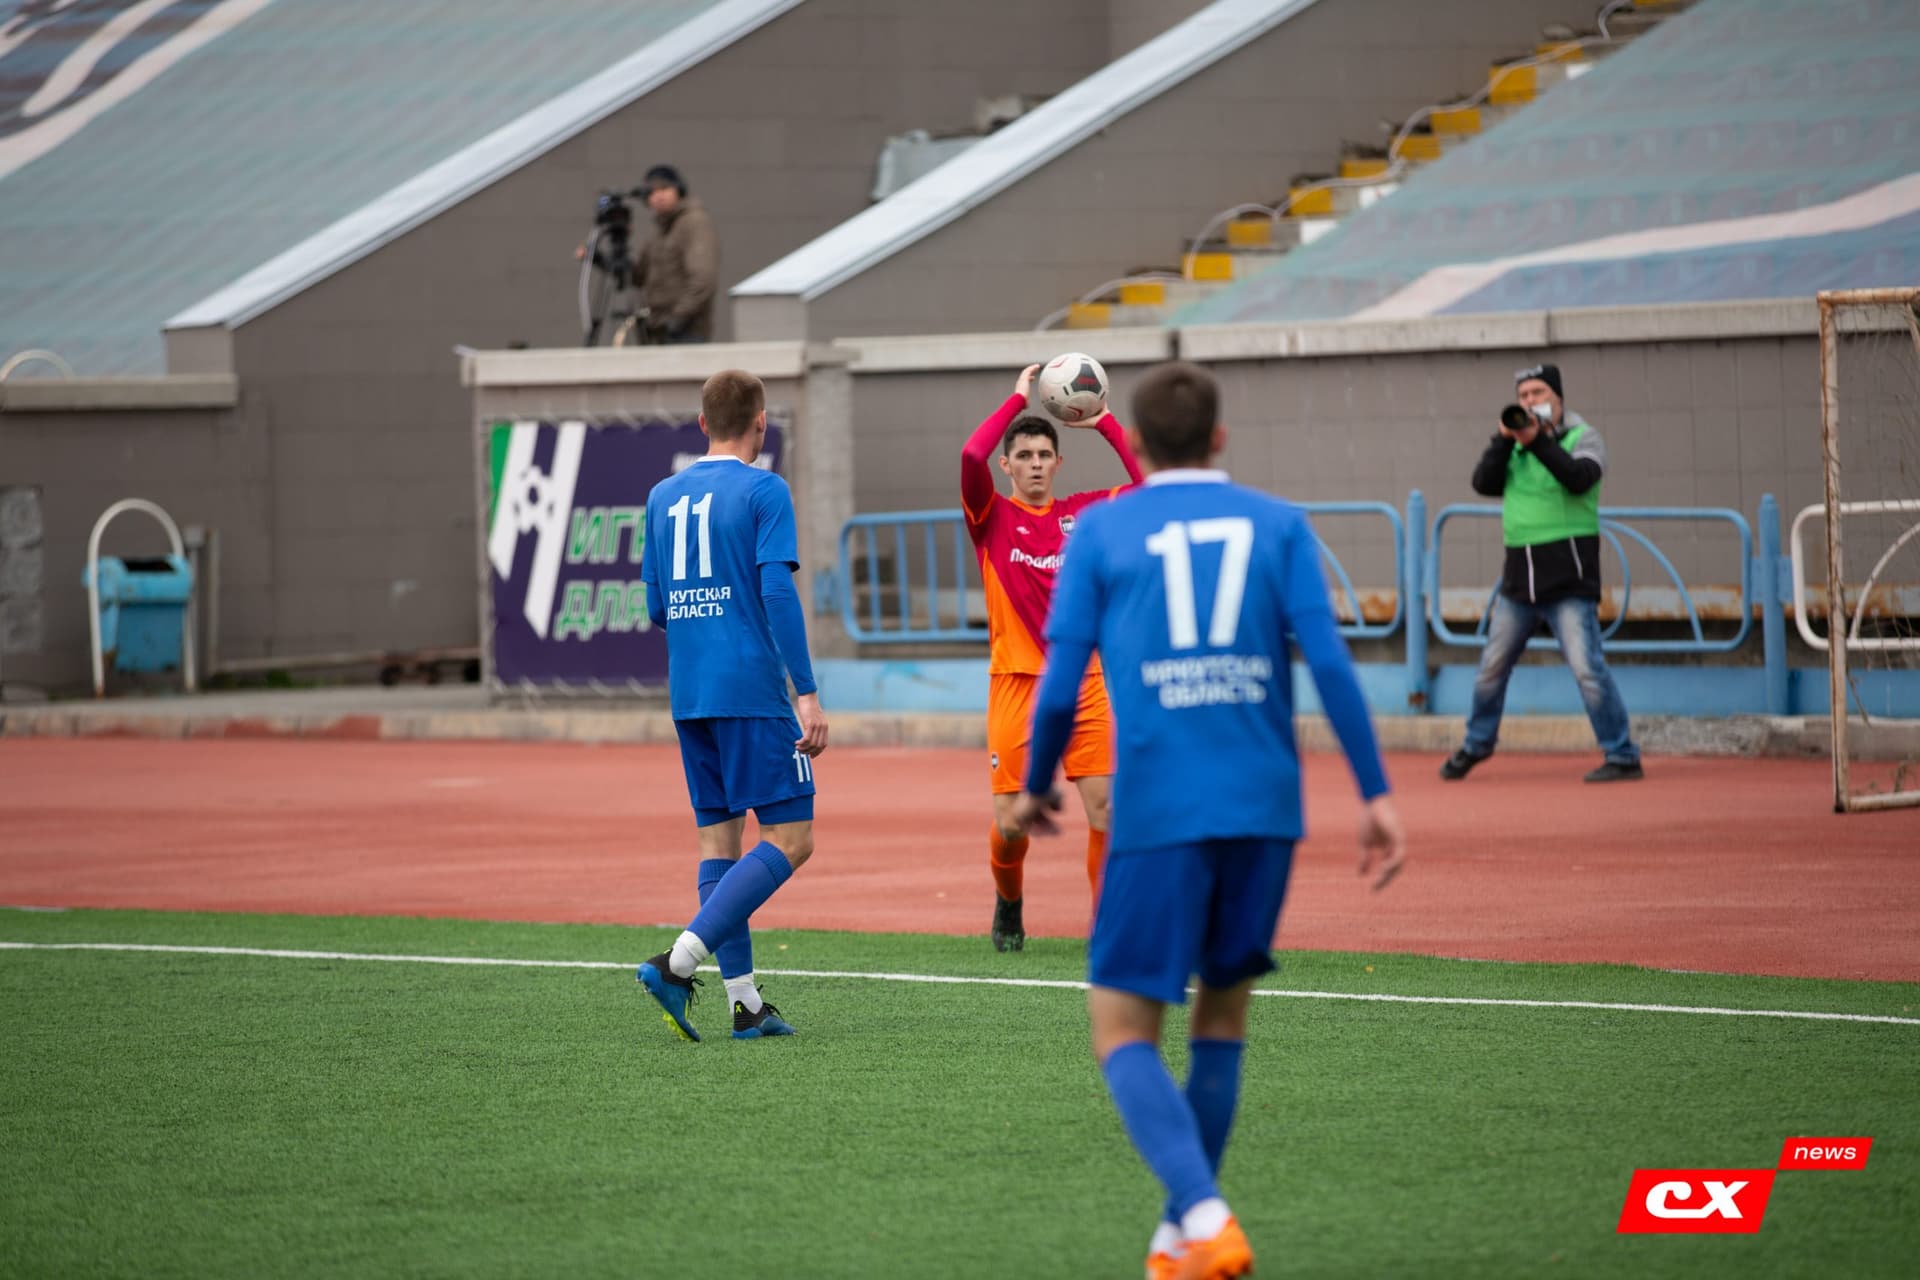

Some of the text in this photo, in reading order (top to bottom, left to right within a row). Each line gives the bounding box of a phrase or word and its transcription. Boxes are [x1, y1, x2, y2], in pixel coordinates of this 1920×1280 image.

[667, 493, 713, 581] 11
[669, 586, 731, 604] КУТСКАЯ
[1145, 516, 1255, 650] 17
